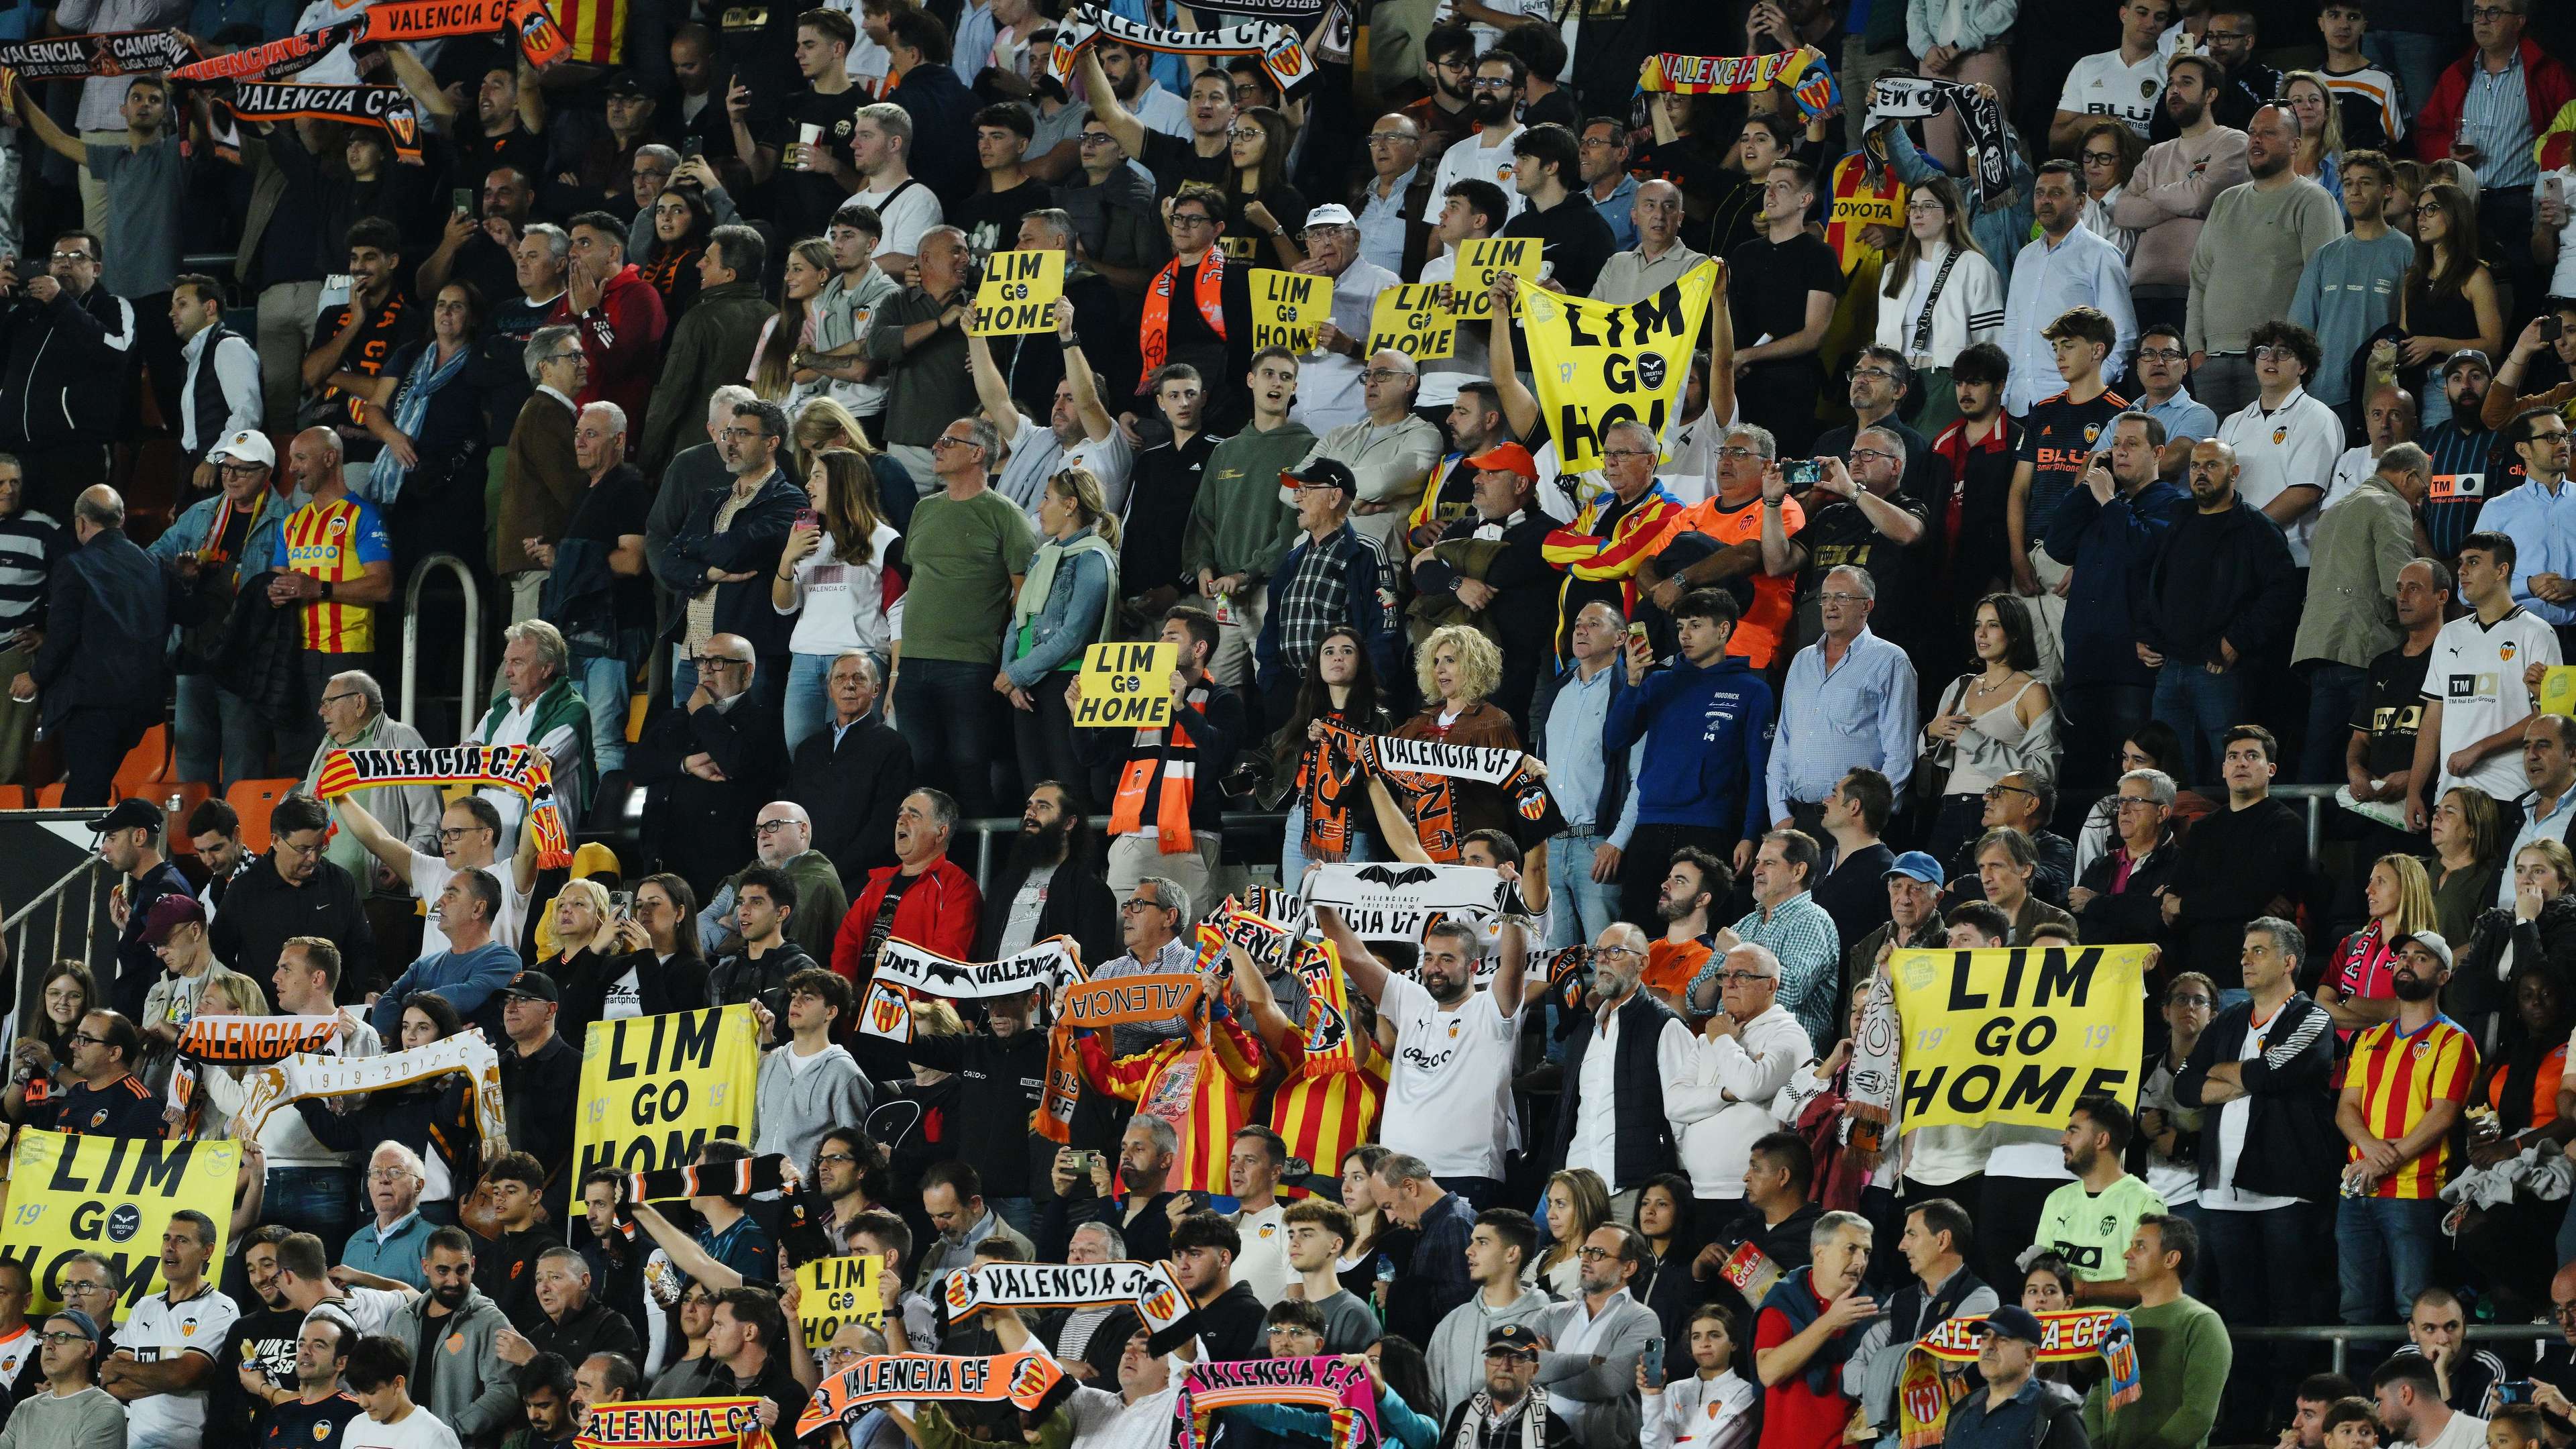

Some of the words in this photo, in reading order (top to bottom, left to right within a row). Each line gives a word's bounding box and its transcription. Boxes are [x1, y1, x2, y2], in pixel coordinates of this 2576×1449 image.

[388, 3, 482, 32] VALENCIA
[1660, 54, 1757, 85] VALENCIA
[235, 86, 352, 112] VALENCIA
[1831, 203, 1892, 219] TOYOTA
[986, 252, 1043, 282] LIM
[1471, 240, 1526, 267] LIM
[1267, 274, 1311, 304] LIM
[1395, 284, 1444, 311] LIM
[973, 304, 1057, 333] HOME
[1563, 281, 1684, 348] LIM
[1256, 324, 1311, 350] HOM
[1370, 329, 1452, 357] HOME
[2036, 464, 2082, 473] smartphone
[2509, 464, 2528, 477] div
[2433, 481, 2451, 492] TM
[1095, 645, 1156, 673] LIM
[1714, 692, 1740, 700] HOODRICH
[2451, 680, 2469, 694] TM
[2478, 696, 2496, 704] Group
[1076, 697, 1169, 722] HOME
[1705, 711, 1734, 720] HOODRICH
[1703, 733, 1715, 743] 14
[347, 746, 482, 779] VALENCIA
[1383, 737, 1478, 771] VALENCIA
[1484, 747, 1511, 775] CF
[1360, 894, 1407, 903] VALENCIA
[881, 949, 920, 979] UNT
[1947, 948, 2104, 1012] LIM
[604, 995, 640, 1006] martphon
[606, 1006, 724, 1082] LIM
[1974, 1016, 2057, 1057] GO
[963, 1069, 987, 1079] CAZOO
[631, 1078, 690, 1127] GO
[1901, 1065, 2129, 1118] HOME
[48, 1135, 196, 1197] LIM
[111, 1223, 134, 1231] LIBERTAD
[814, 1258, 865, 1291] LIM
[985, 1267, 1115, 1299] VALENCIA
[1928, 1319, 2061, 1351] ALEA
[2072, 1314, 2113, 1347] CF
[140, 1352, 156, 1362] TM
[256, 1339, 296, 1356] NIKE
[274, 1358, 297, 1375] SB
[843, 1358, 953, 1401] VALENCIA
[959, 1358, 989, 1393] CF
[1189, 1358, 1314, 1391] VALENCIA
[584, 1409, 717, 1443] ALENCIA
